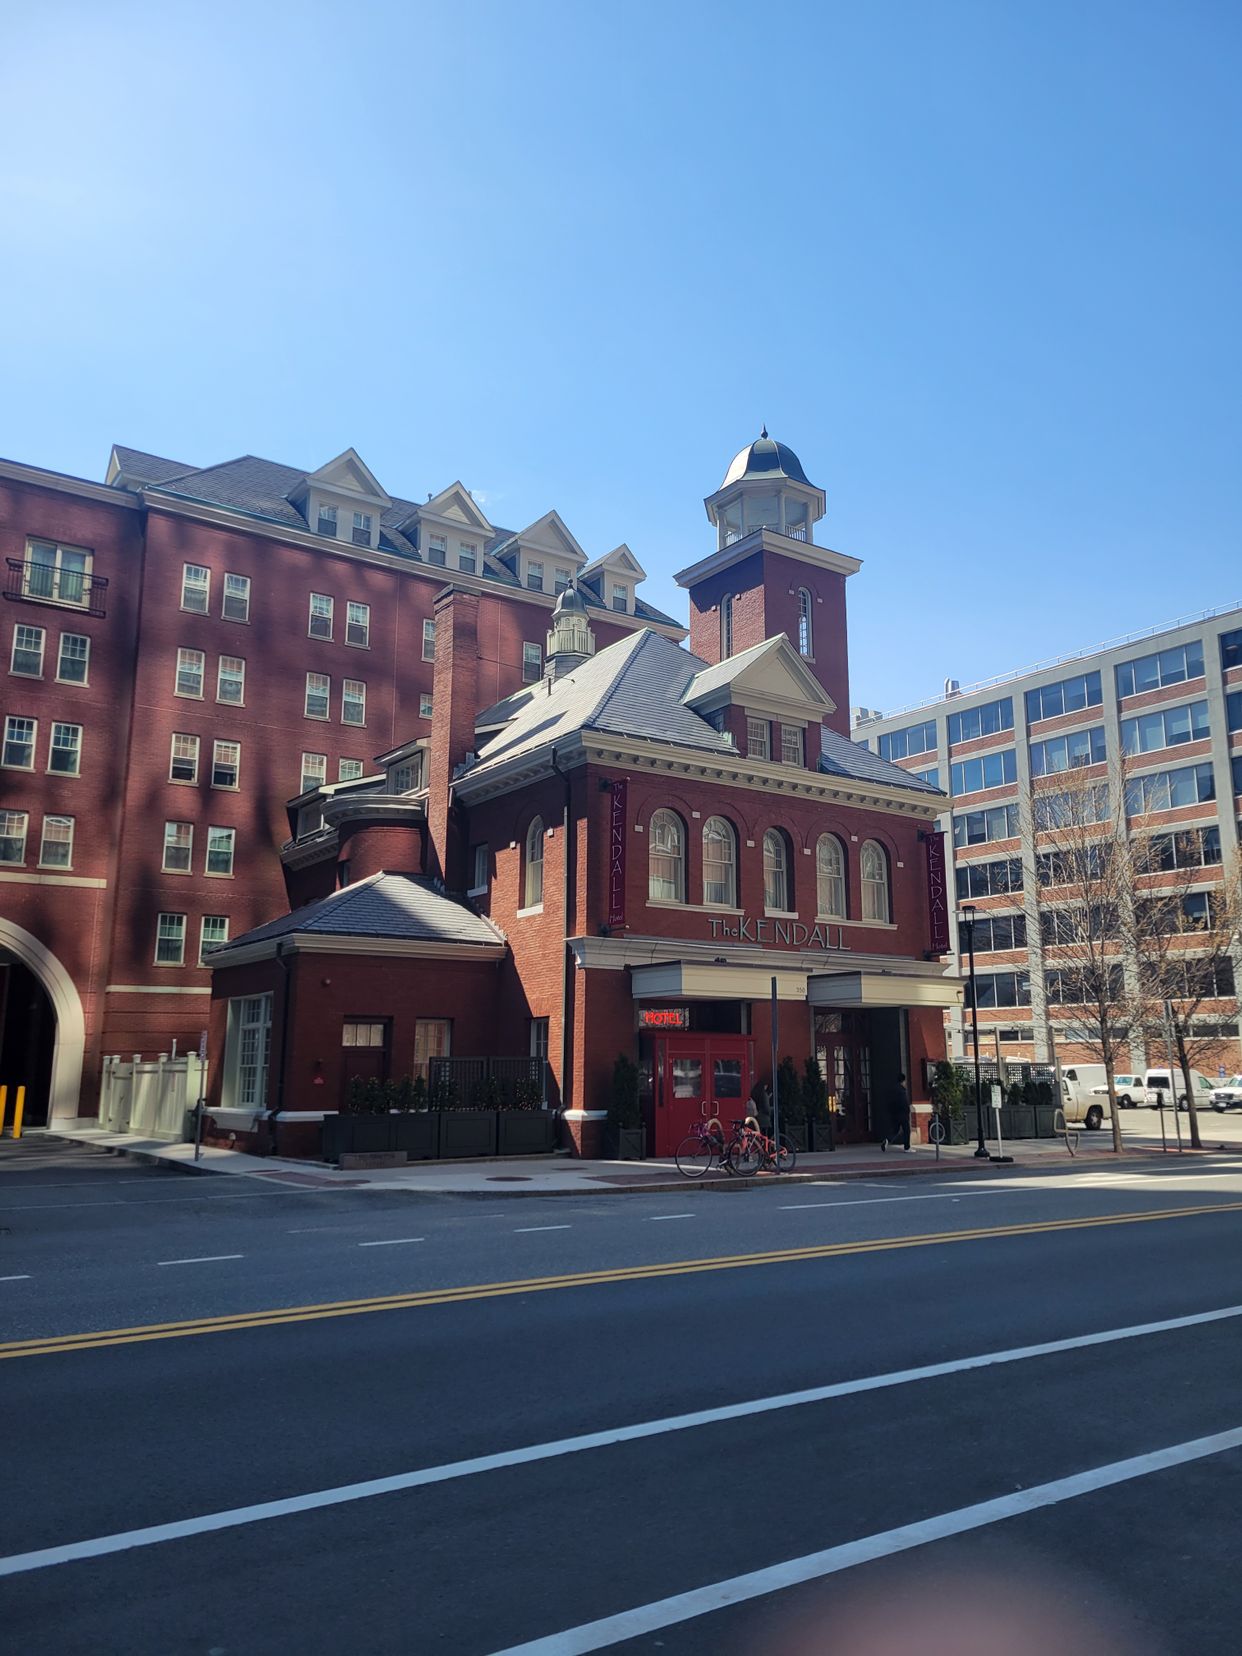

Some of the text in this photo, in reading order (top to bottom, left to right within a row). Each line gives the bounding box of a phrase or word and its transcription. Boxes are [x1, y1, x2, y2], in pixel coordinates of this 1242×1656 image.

[611, 793, 623, 909] KENDALL
[930, 844, 944, 939] KENDALL
[739, 916, 851, 950] KENDALL
